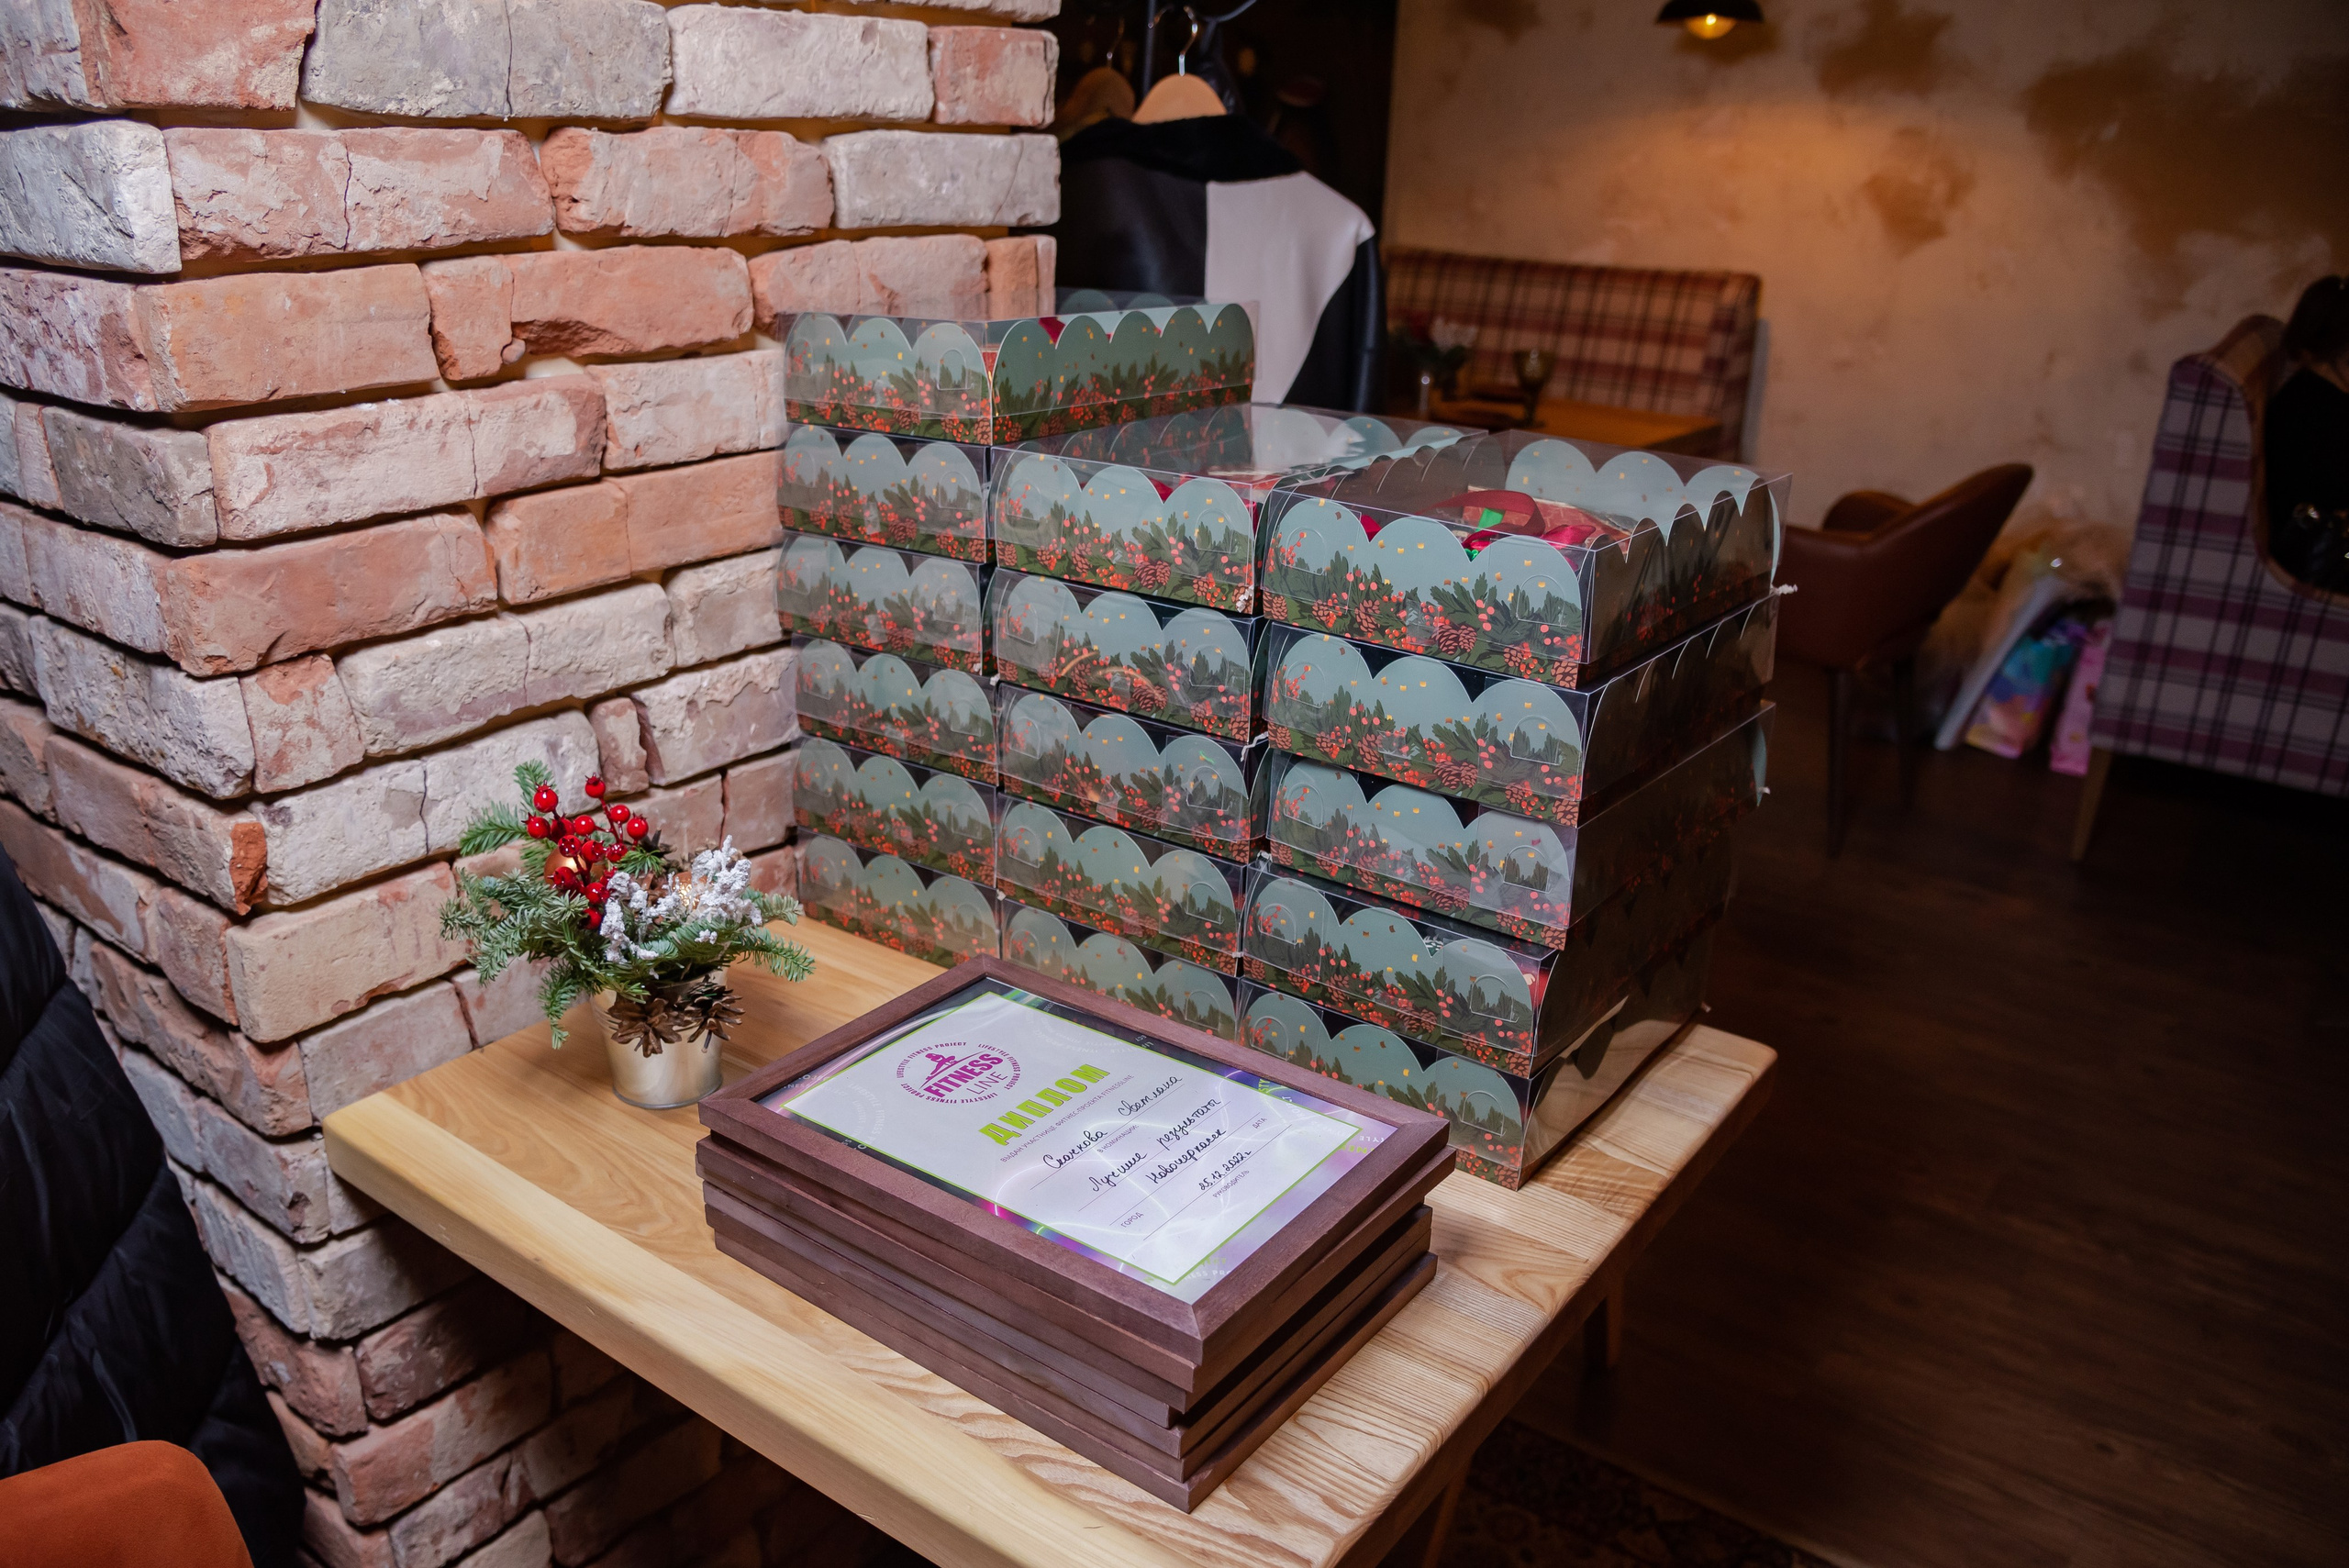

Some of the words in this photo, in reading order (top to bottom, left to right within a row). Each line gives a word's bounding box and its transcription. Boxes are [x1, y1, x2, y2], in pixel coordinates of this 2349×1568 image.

[978, 1043, 1009, 1057] LIFESTYLE
[896, 1059, 910, 1078] LIFESTYLE
[907, 1046, 933, 1059] FITNESS
[1008, 1057, 1020, 1073] FITNESS
[923, 1053, 1004, 1097] FITNESS
[966, 1072, 1008, 1095] LINE
[1004, 1073, 1020, 1090] PROJECT
[901, 1083, 925, 1098] PROJECT
[961, 1092, 998, 1104] LIFESTYLE
[926, 1095, 957, 1104] FITNESS
[978, 1064, 1110, 1146] ДИПЛОМ
[1000, 1146, 1024, 1162] ВЫДАН
[1021, 1125, 1057, 1149] УЧАСТНИЦЕ
[1055, 1095, 1103, 1127] ФИТНЕС-ПРОЕКТА
[1101, 1074, 1134, 1098] FITNESSLINE
[1252, 1117, 1268, 1129] ДАТА
[1088, 1152, 1148, 1193] Лучшие
[1212, 1169, 1250, 1198] РУКОВОДИТЕЛЬ
[1120, 1211, 1144, 1228] ГОРОД
